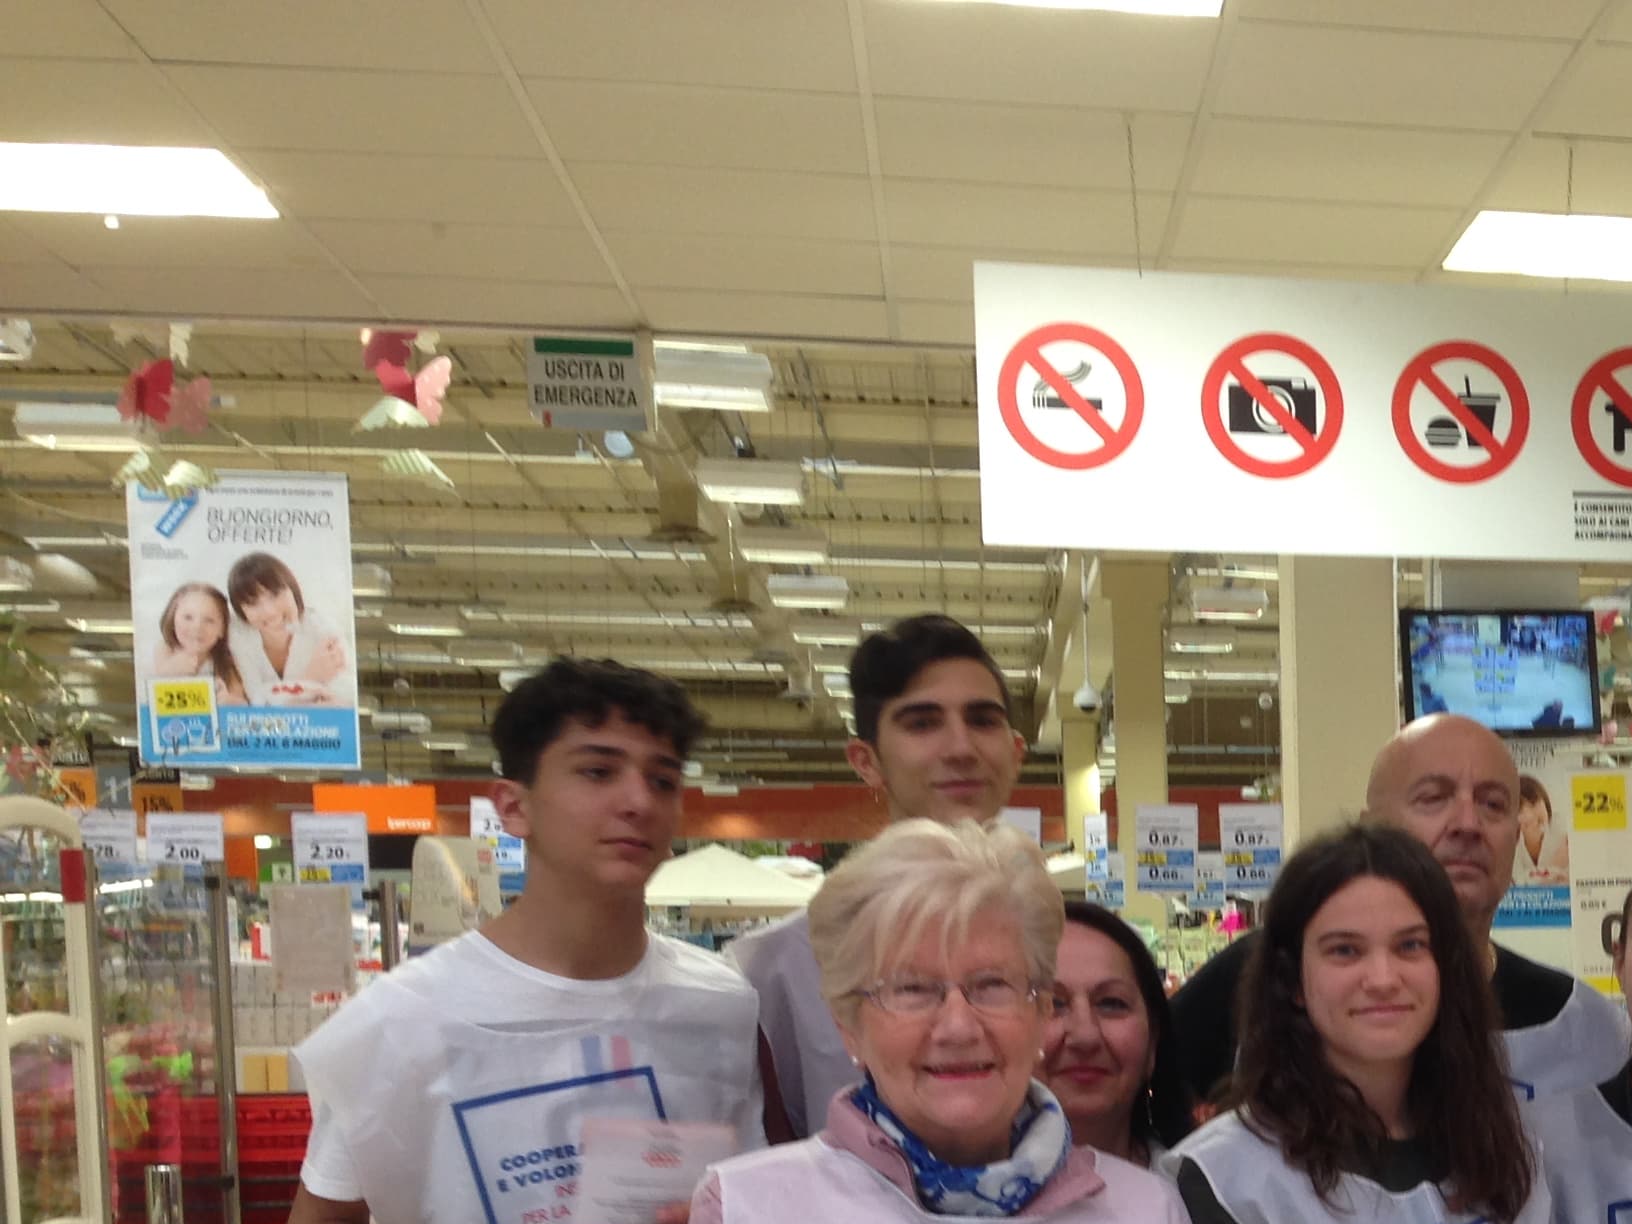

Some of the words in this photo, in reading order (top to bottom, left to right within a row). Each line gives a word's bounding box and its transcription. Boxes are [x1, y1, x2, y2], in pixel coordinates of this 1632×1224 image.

[544, 359, 604, 380] USCITA
[608, 361, 625, 381] DI
[534, 384, 637, 408] EMERGENZA
[206, 506, 334, 531] BUONGIORNO,
[207, 525, 293, 545] OFFERTE!
[1575, 793, 1623, 813] -22%
[522, 1208, 549, 1224] PER
